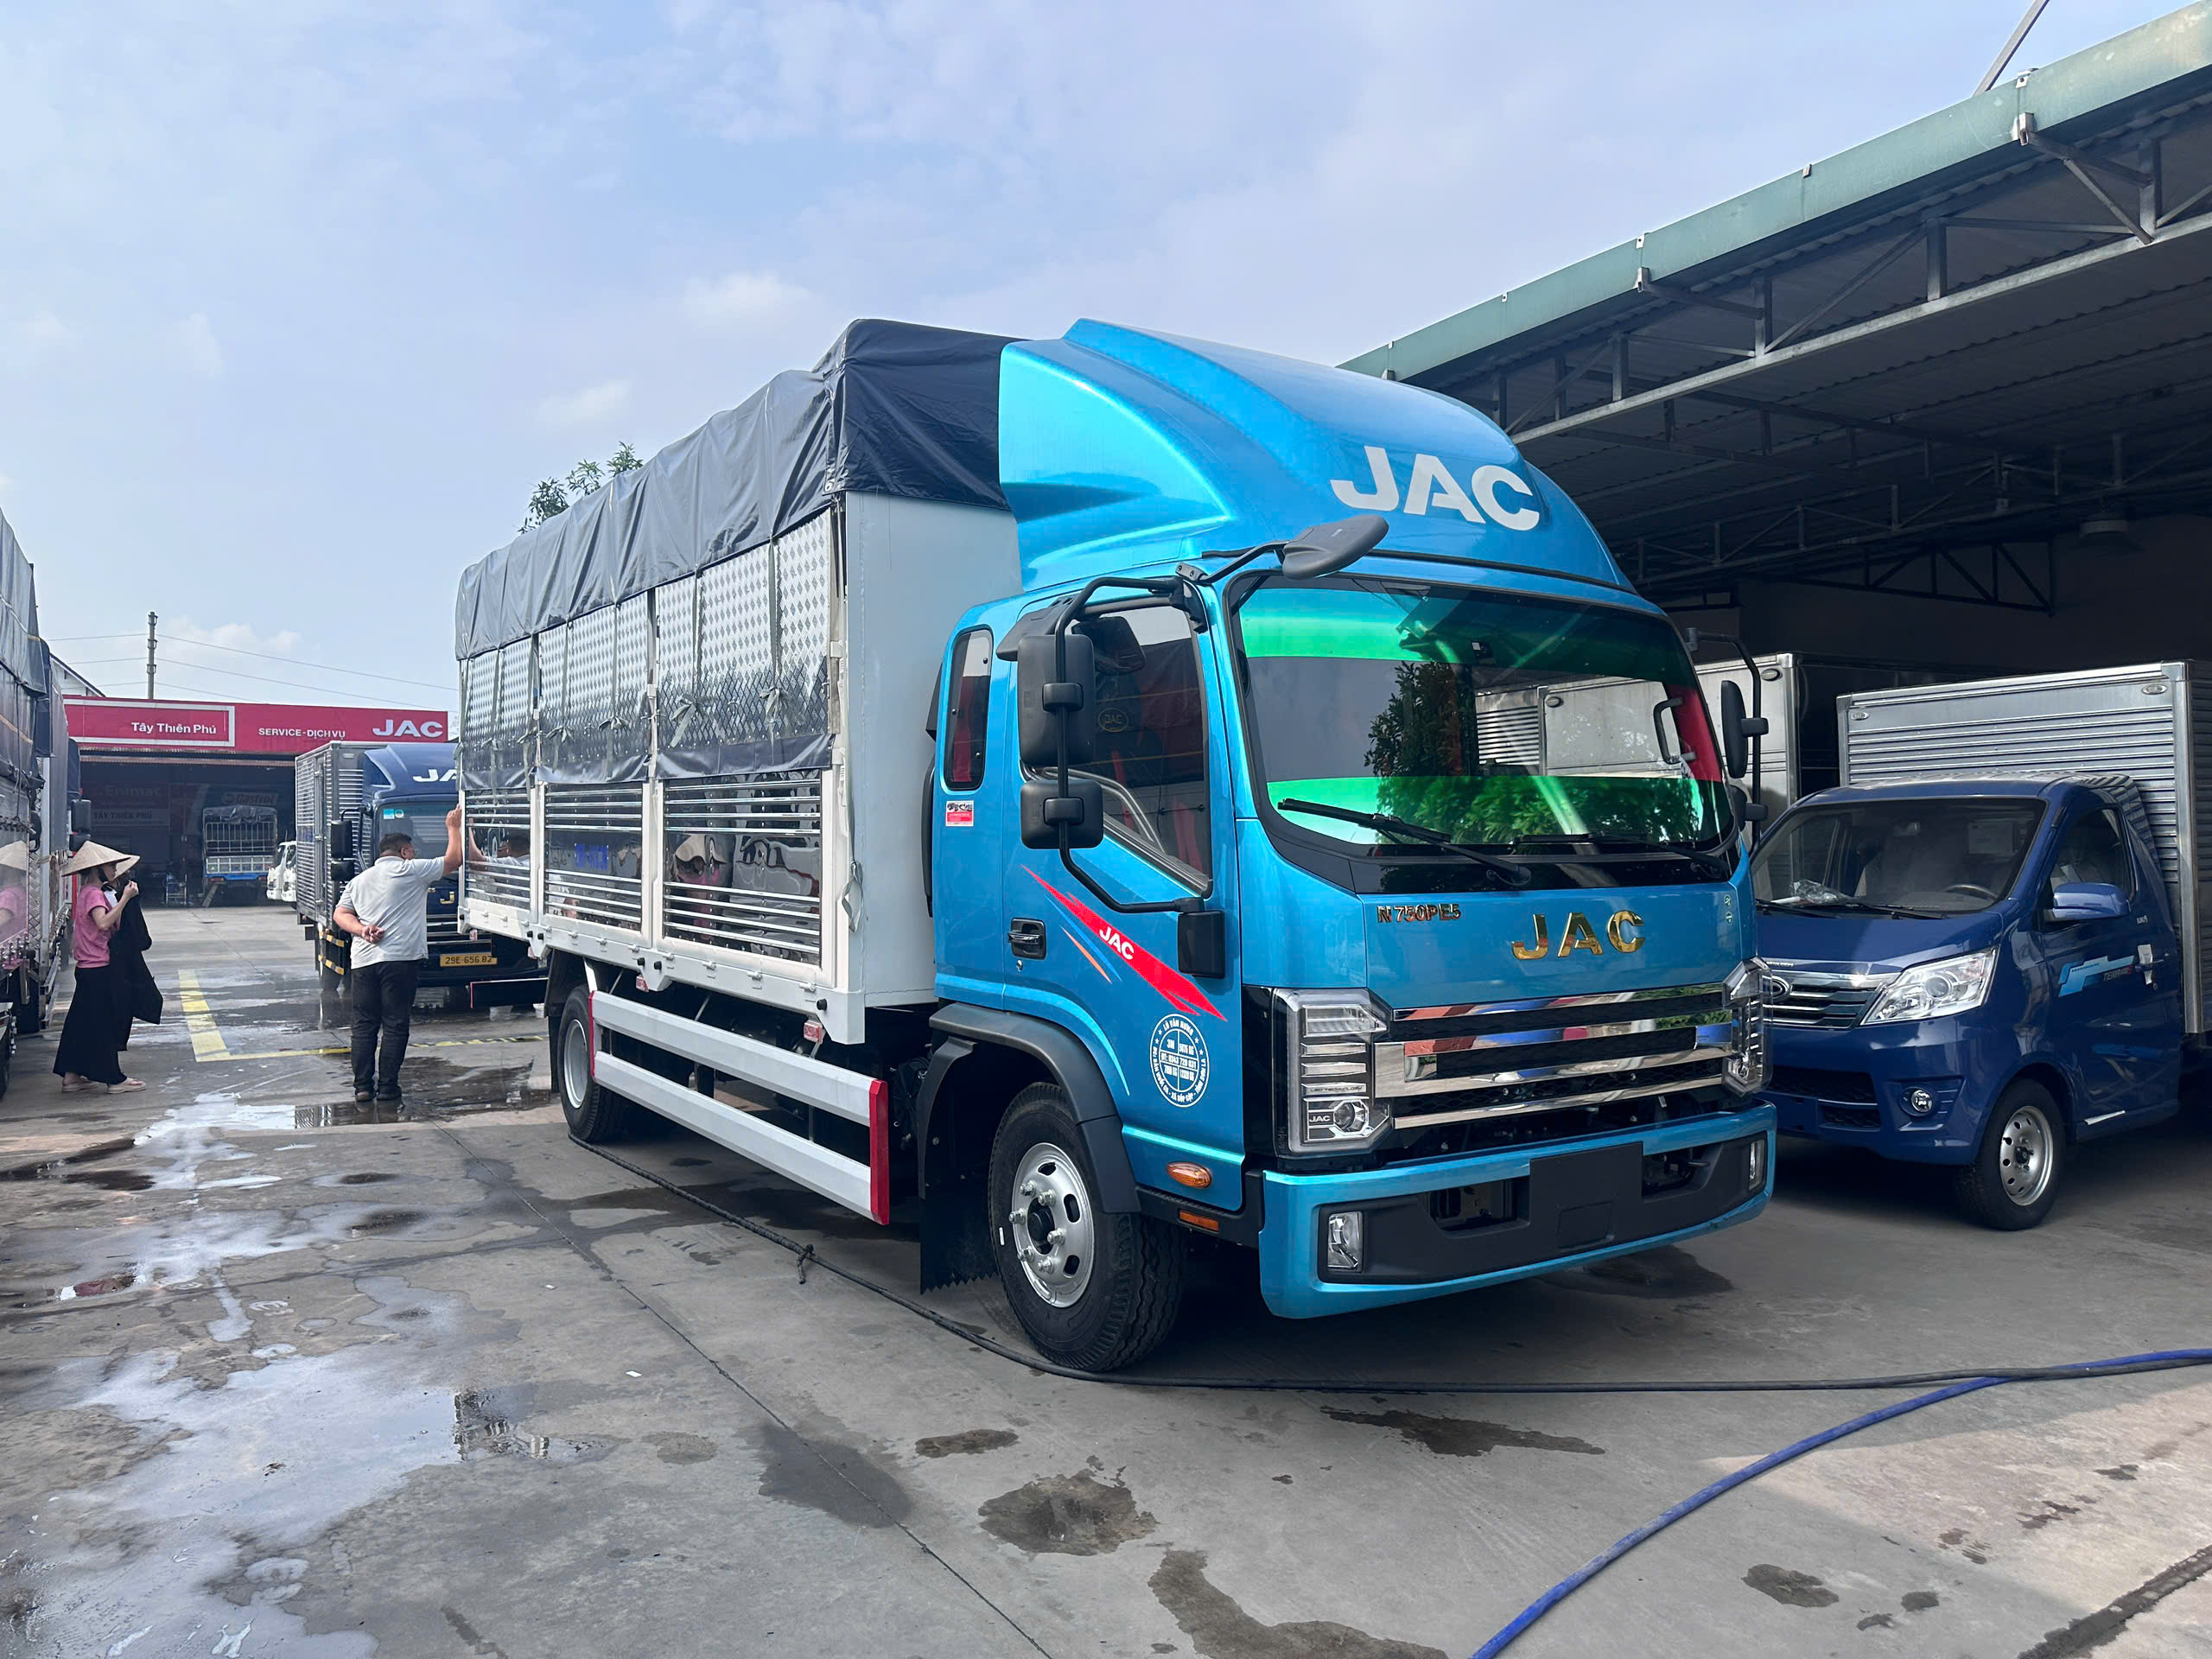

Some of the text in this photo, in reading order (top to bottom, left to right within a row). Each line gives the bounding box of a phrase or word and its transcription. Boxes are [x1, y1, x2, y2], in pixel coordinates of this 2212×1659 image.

[1330, 445, 1540, 531] JAC
[131, 721, 216, 734] Tây Thiên Phú
[258, 728, 302, 737] SERVICE
[372, 719, 443, 737] JAC
[412, 769, 457, 782] JA
[1099, 925, 1135, 960] JAC
[1510, 910, 1645, 960] JAC
[445, 956, 493, 965] 29E-656.82
